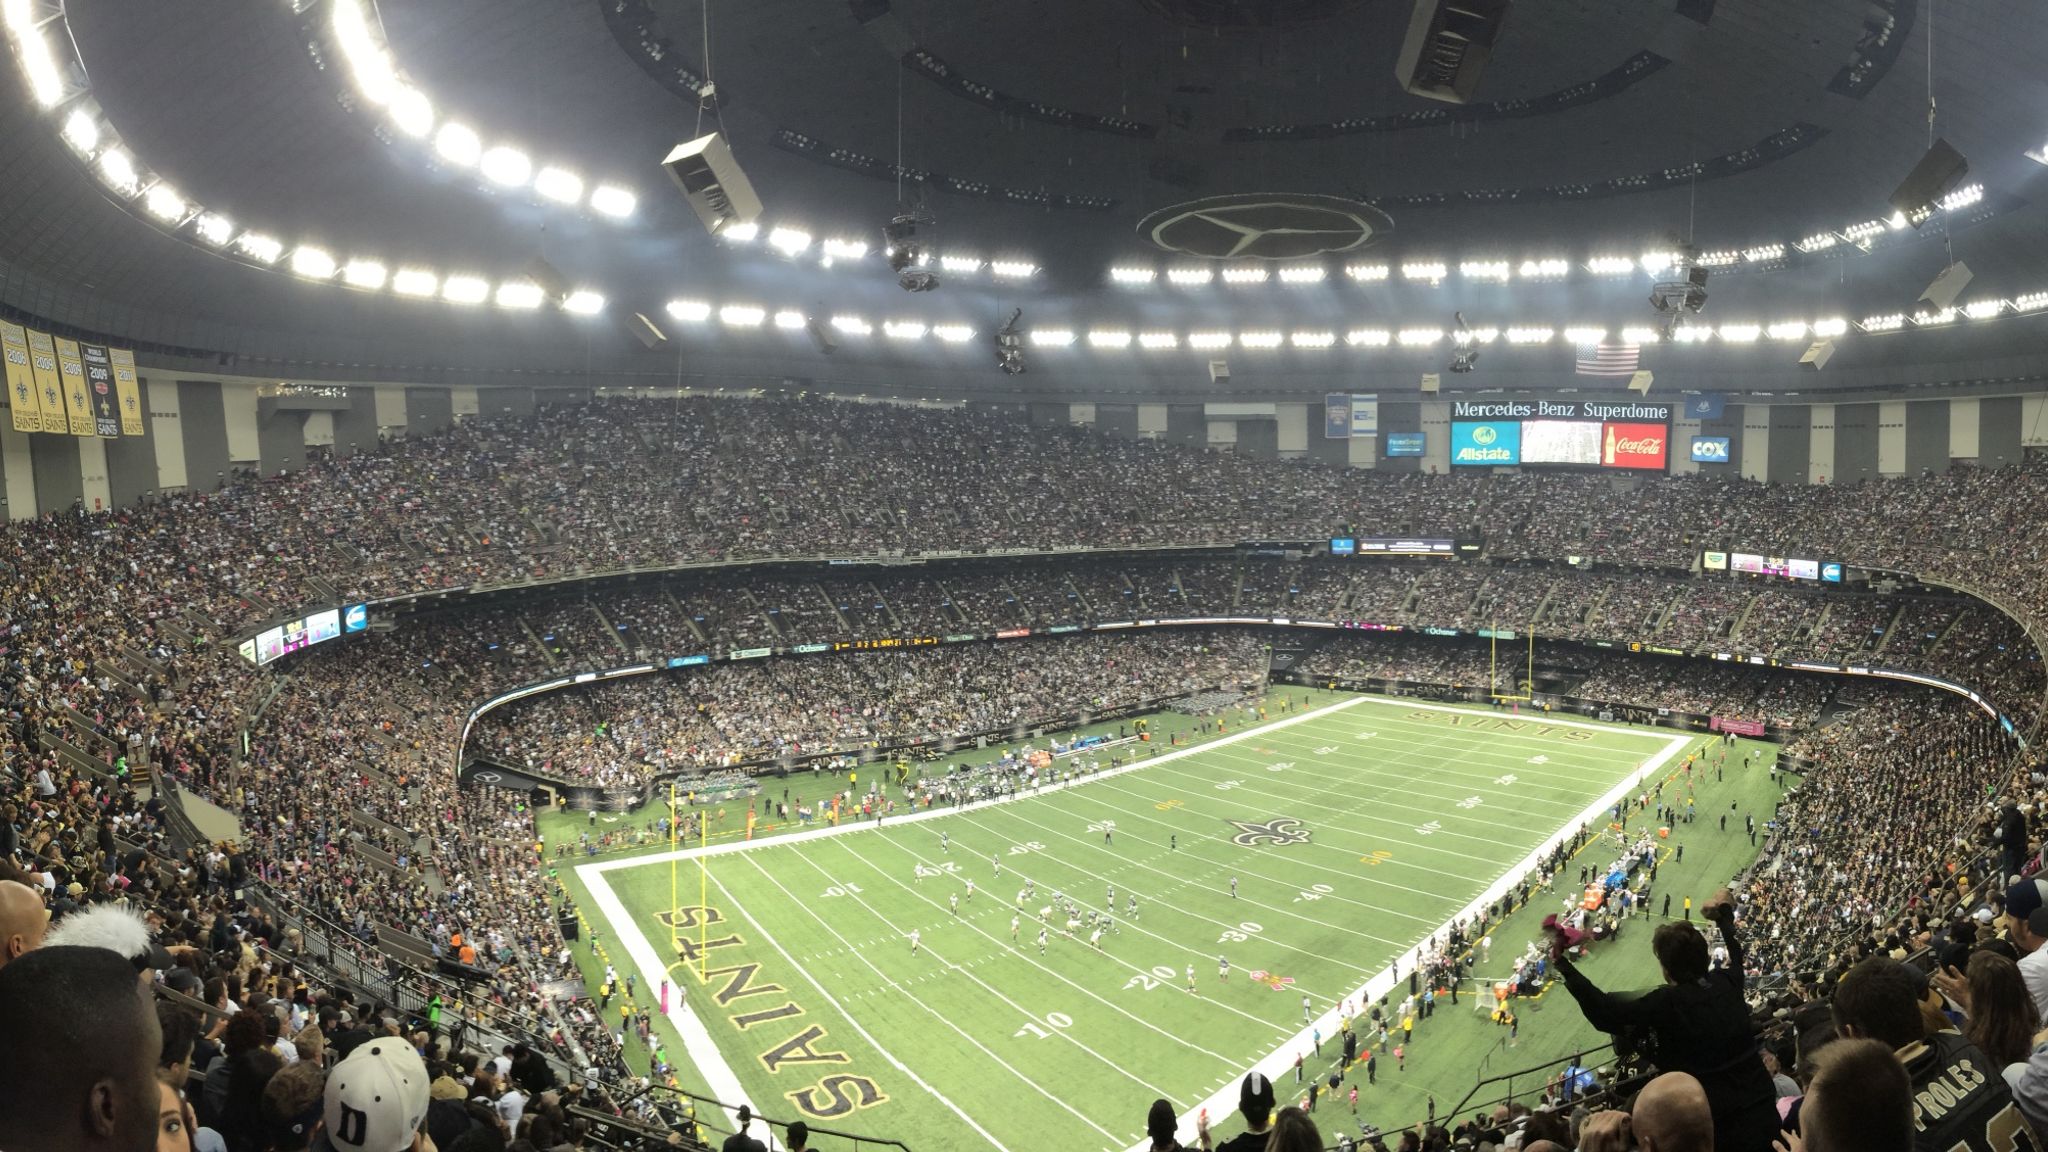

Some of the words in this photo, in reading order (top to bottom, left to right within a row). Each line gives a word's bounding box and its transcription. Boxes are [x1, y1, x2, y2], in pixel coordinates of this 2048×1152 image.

[8, 349, 27, 365] 2006
[35, 355, 54, 371] 2009
[64, 361, 83, 376] 2009
[90, 366, 108, 380] 2009
[1454, 401, 1575, 417] Mercedes-Benz
[1583, 402, 1668, 420] Superdome
[15, 416, 40, 430] SAINTS
[45, 418, 67, 431] SAINTS
[72, 421, 93, 433] SAINTS
[98, 423, 118, 436] SAINTS
[124, 423, 143, 433] SAINTS
[1456, 447, 1511, 461] Allstate
[1692, 441, 1728, 457] COX
[1407, 710, 1596, 742] SAINTS
[1360, 850, 1393, 865] 50
[921, 861, 964, 878] 20
[825, 882, 864, 898] 10
[1301, 884, 1335, 901] 40
[1223, 922, 1264, 944] 30
[1132, 966, 1177, 991] 20
[653, 906, 890, 1120] SAINTS
[1022, 1012, 1073, 1040] 10
[336, 1100, 368, 1147] D
